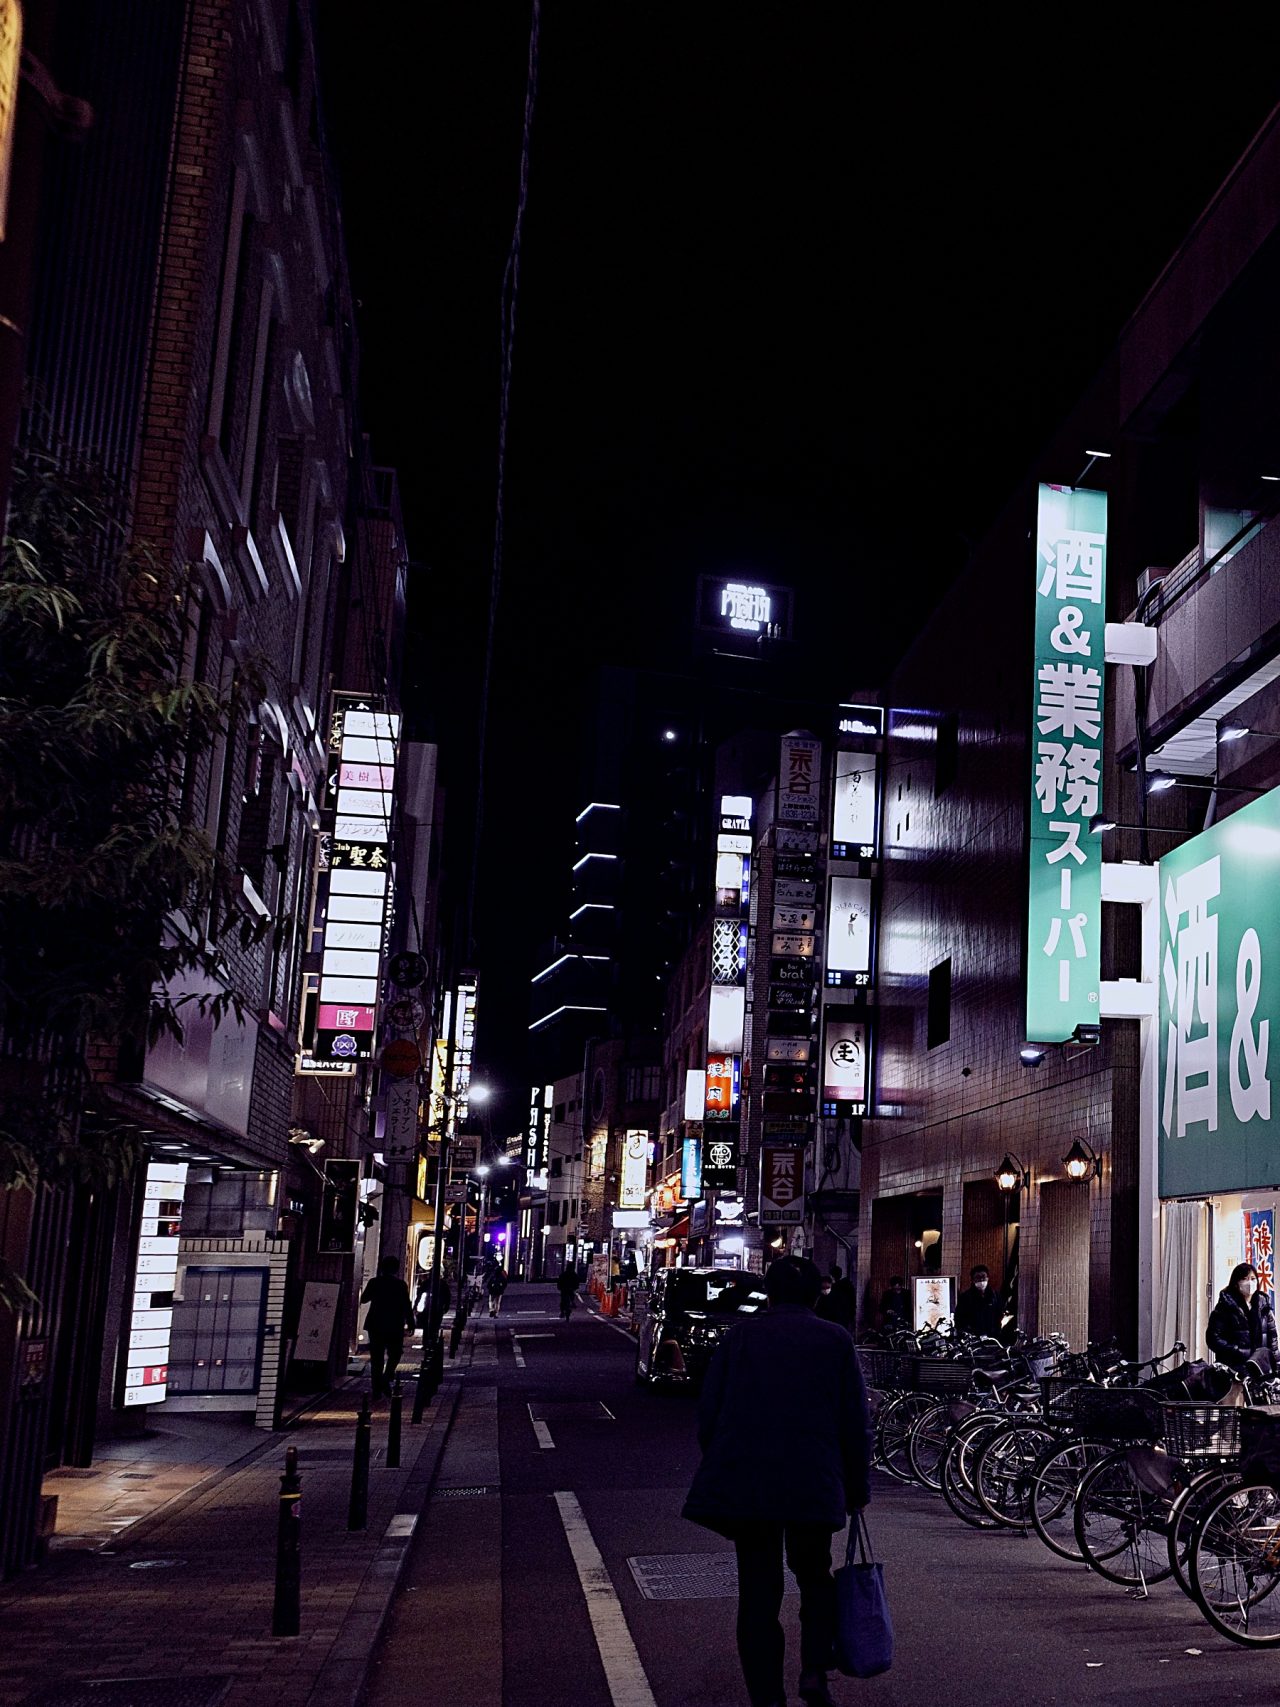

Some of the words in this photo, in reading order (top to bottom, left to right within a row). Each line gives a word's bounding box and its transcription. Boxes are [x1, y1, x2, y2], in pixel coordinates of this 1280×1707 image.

[1036, 530, 1105, 1002] 酒&業務スーパー
[350, 846, 387, 868] 聖奈
[860, 846, 874, 858] 3F
[855, 974, 870, 986] 2F
[706, 1062, 725, 1102] 焼肉
[852, 1104, 866, 1116] 1F
[526, 1087, 540, 1188] PASHA
